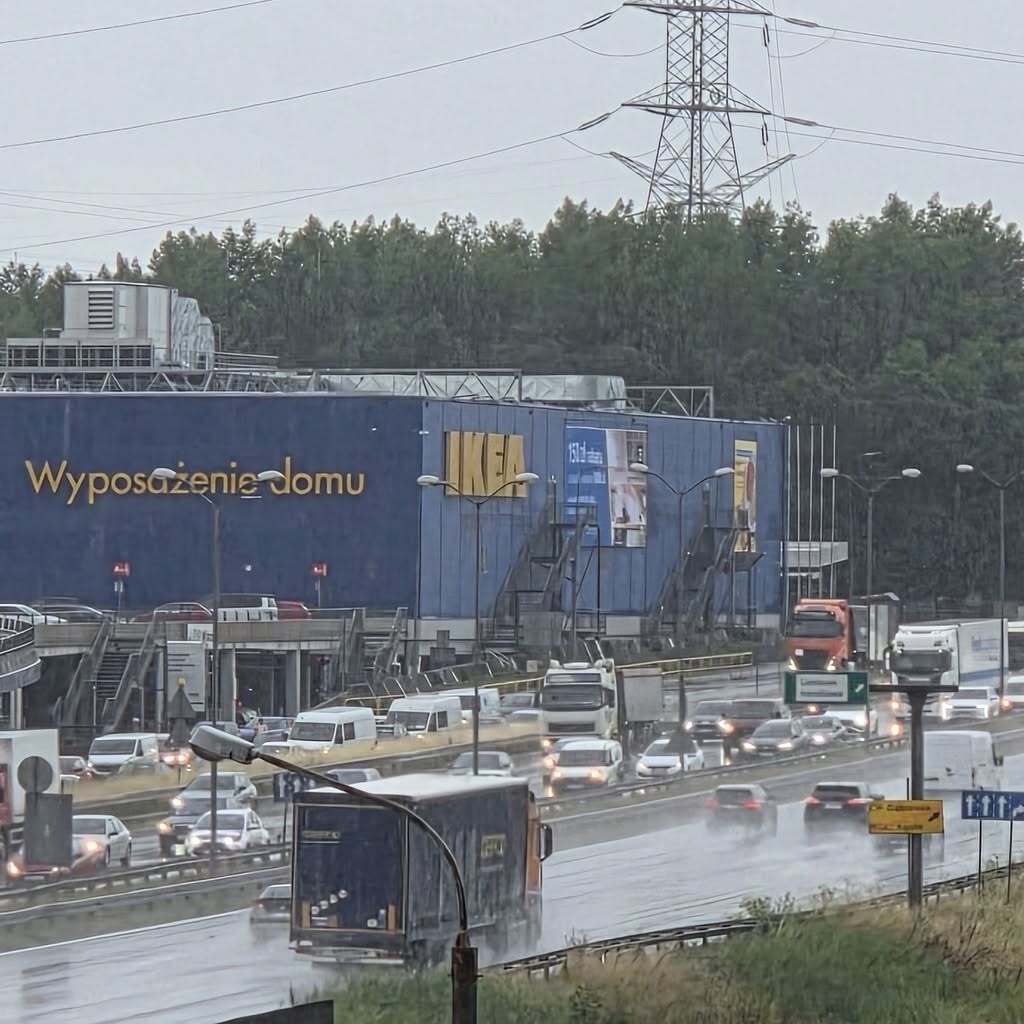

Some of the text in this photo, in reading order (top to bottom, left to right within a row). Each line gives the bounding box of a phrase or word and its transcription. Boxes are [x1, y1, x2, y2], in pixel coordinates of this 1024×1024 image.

[25, 456, 365, 504] Wyposażenie domu
[446, 431, 529, 497] IKEA
